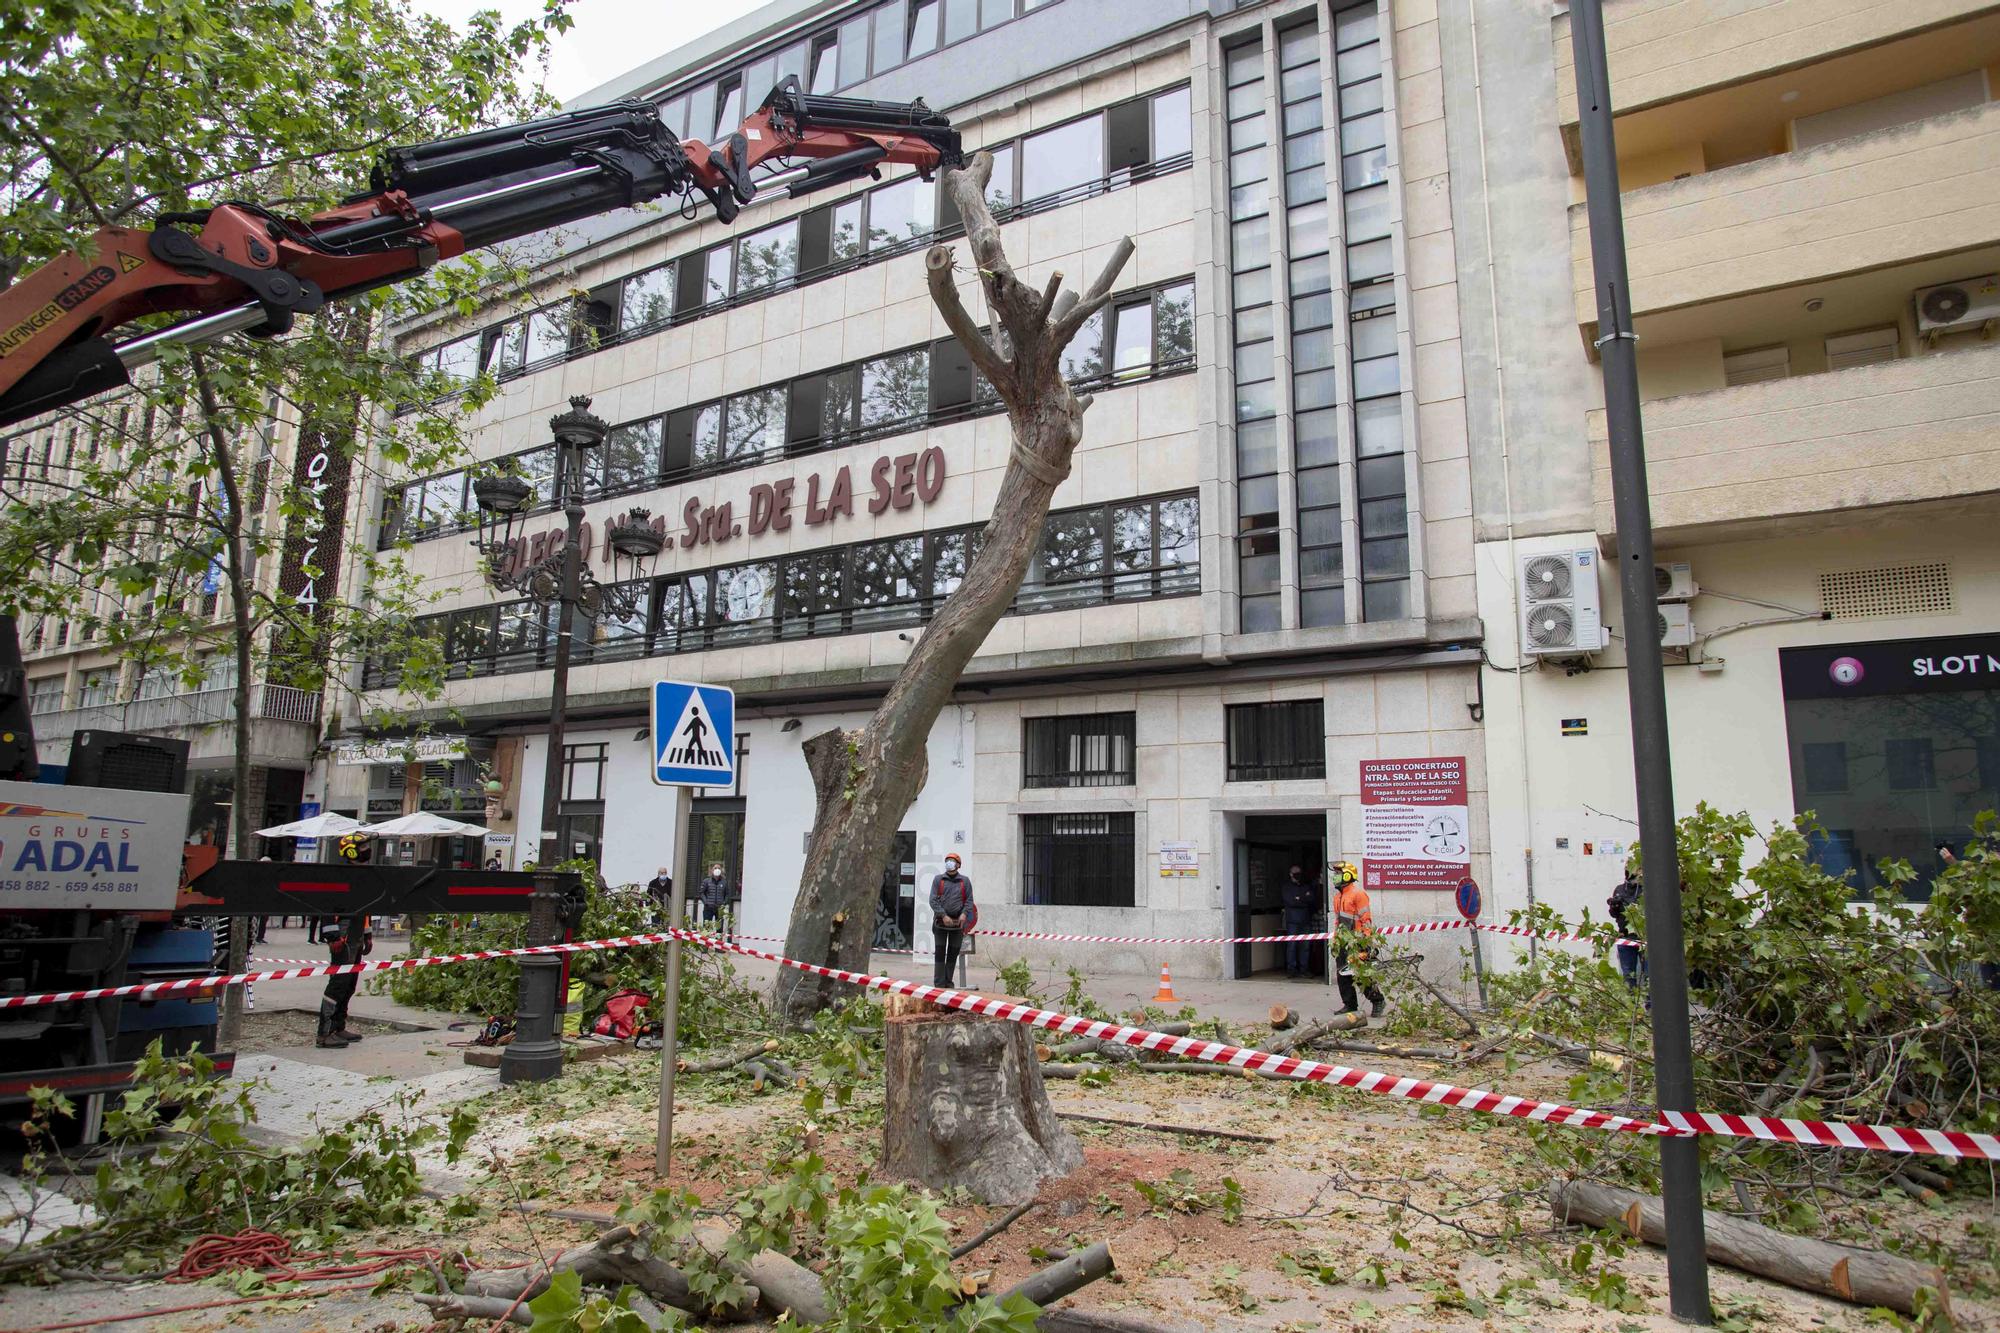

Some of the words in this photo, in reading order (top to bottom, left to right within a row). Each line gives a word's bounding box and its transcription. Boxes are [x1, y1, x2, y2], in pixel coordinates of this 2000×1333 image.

[57, 268, 112, 309] CRANE
[681, 496, 742, 549] Sra.
[748, 477, 795, 535] DE
[805, 465, 854, 525] LA
[868, 446, 945, 513] SEO
[1912, 654, 1980, 676] SLOT
[1365, 764, 1401, 772] COLEGIO
[1403, 762, 1459, 770] CONCERTADO
[1365, 774, 1391, 782] NTRA.
[28, 825, 131, 840] GRUES
[12, 839, 139, 873] ADAL
[25, 880, 50, 891] 882
[65, 882, 88, 892] 659
[92, 882, 114, 892] 458
[118, 883, 139, 892] 881
